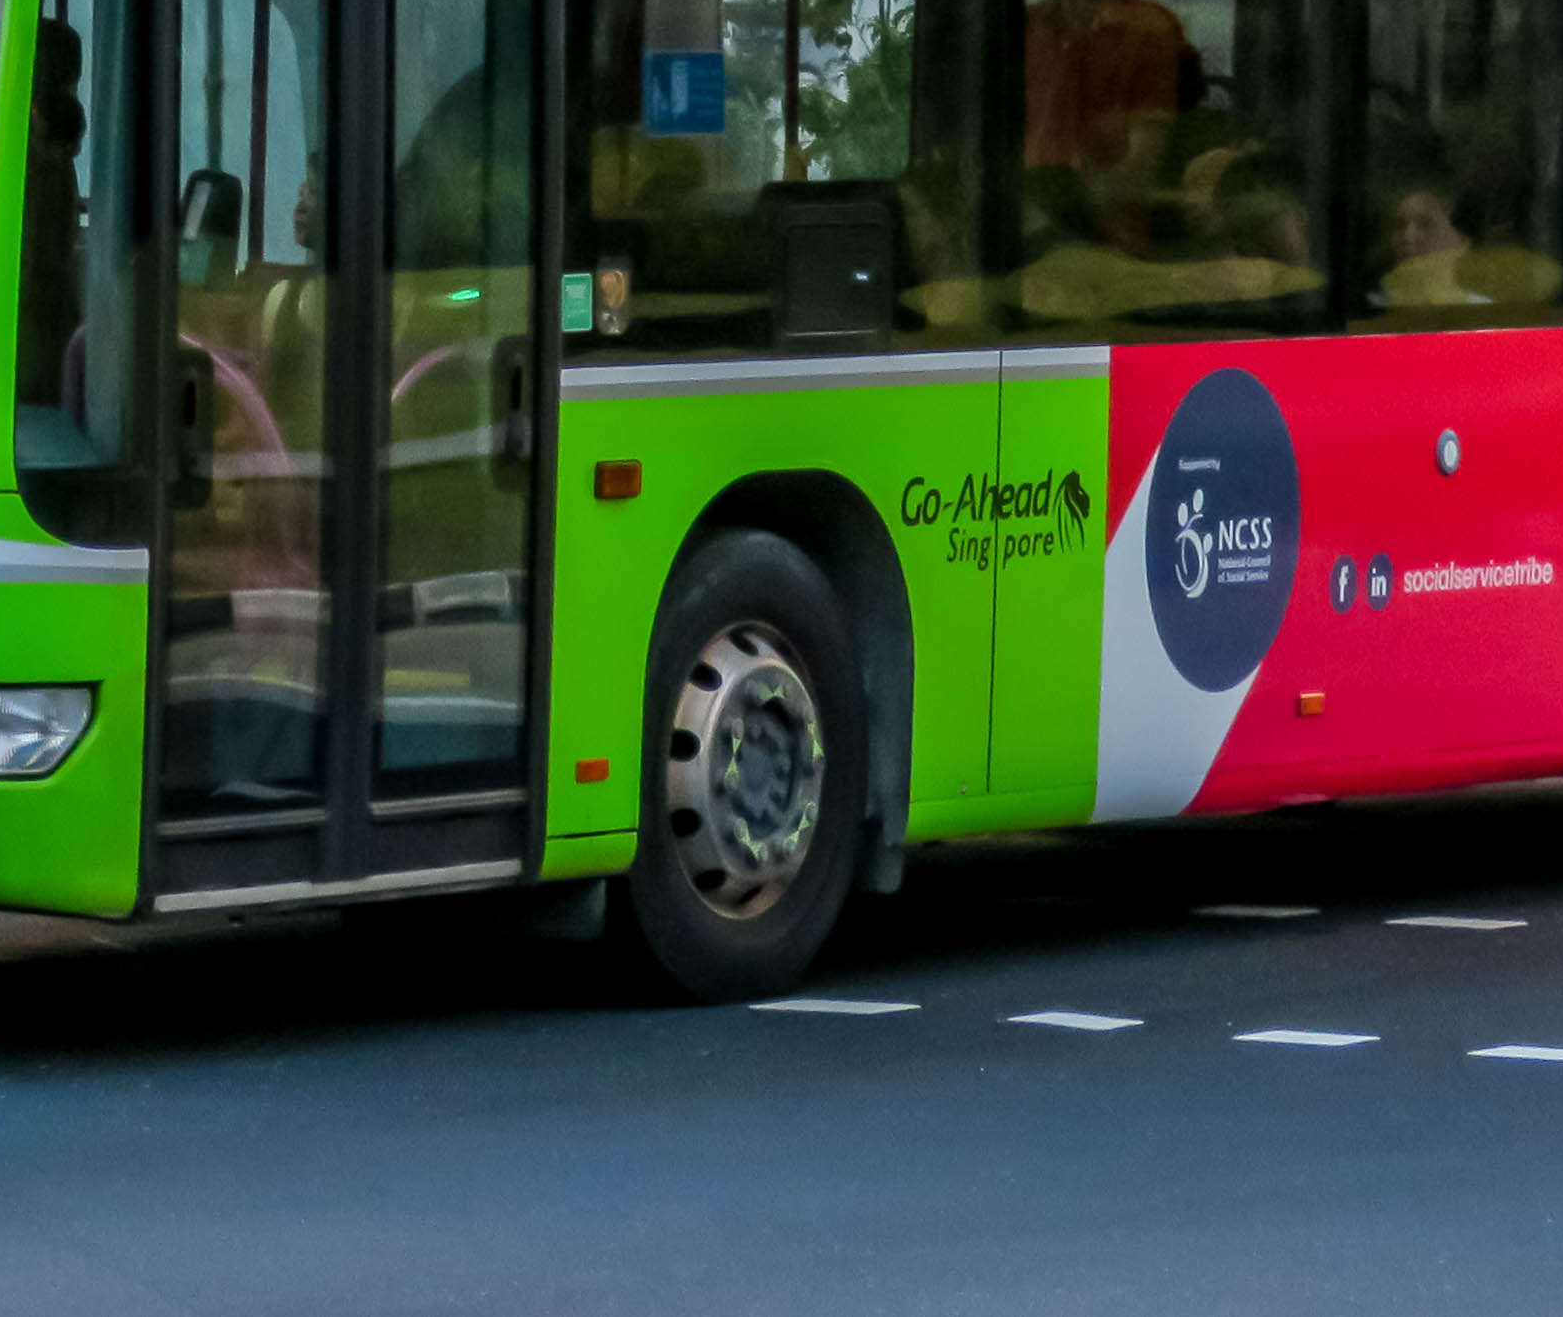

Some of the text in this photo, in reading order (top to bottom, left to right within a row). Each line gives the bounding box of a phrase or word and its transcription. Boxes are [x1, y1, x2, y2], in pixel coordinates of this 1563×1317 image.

[900, 467, 1054, 527] Go-Ahead
[1218, 517, 1273, 551] NCSS
[1370, 567, 1387, 597] in
[1403, 555, 1554, 594] socialservicetribe
